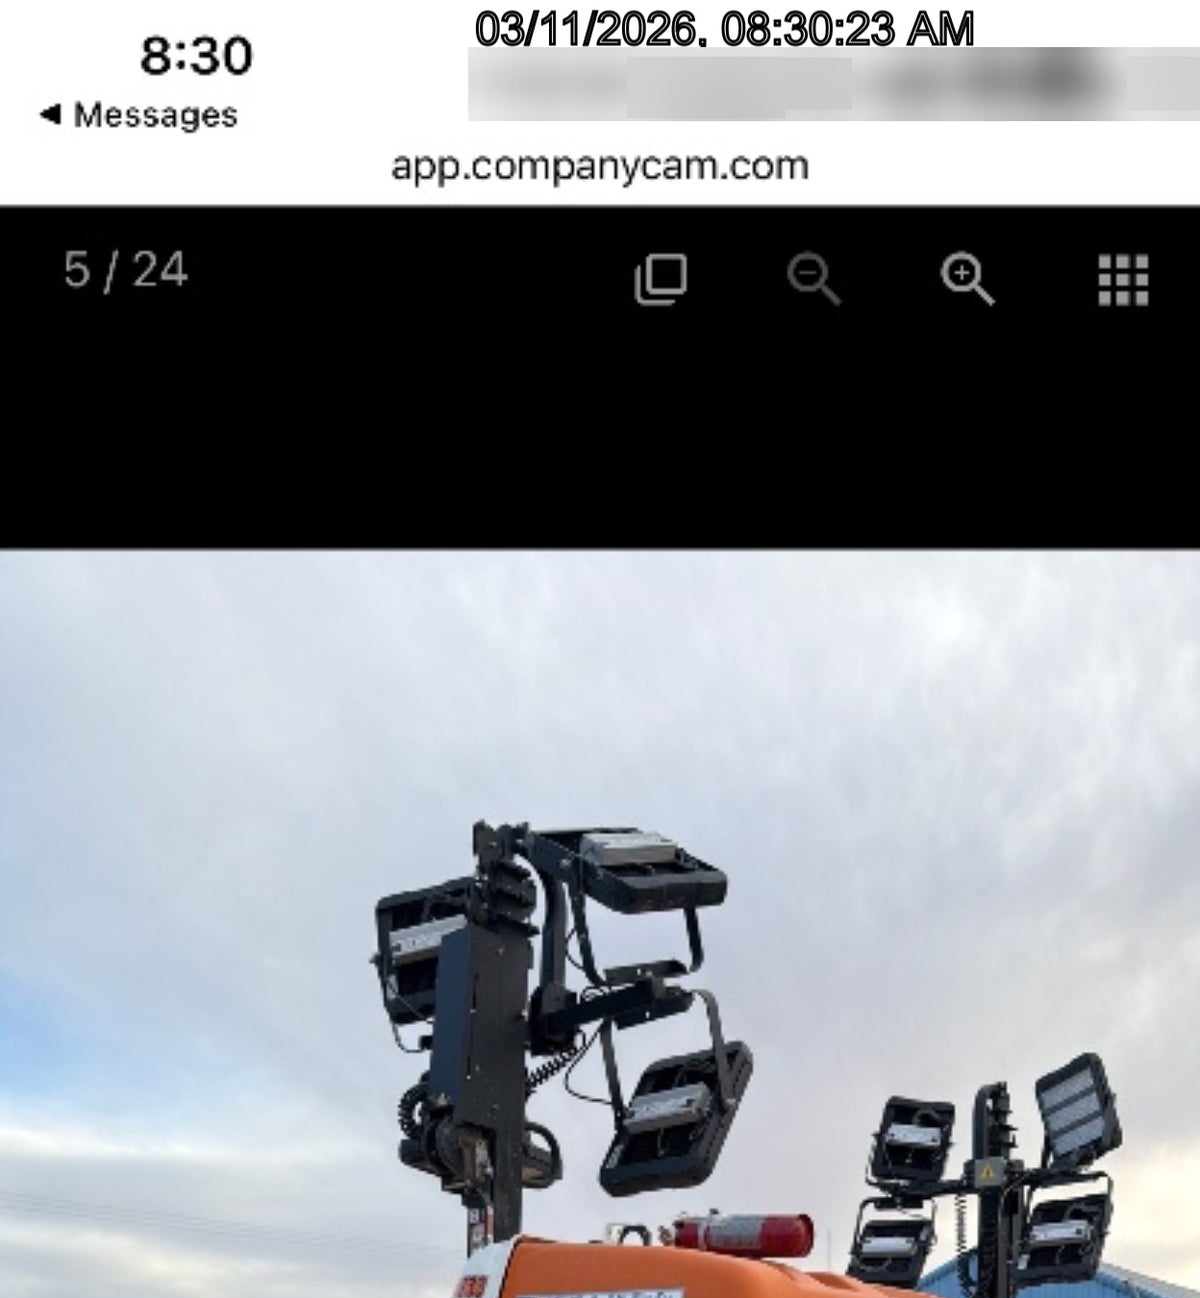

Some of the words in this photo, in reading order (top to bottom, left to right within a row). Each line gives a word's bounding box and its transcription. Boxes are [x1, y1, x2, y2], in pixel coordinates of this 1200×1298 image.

[140, 35, 253, 76] 8:30
[75, 101, 238, 134] Messages
[391, 155, 809, 189] app.companycam.com
[65, 250, 90, 288] 5
[103, 250, 119, 295] /
[134, 250, 189, 288] 24
